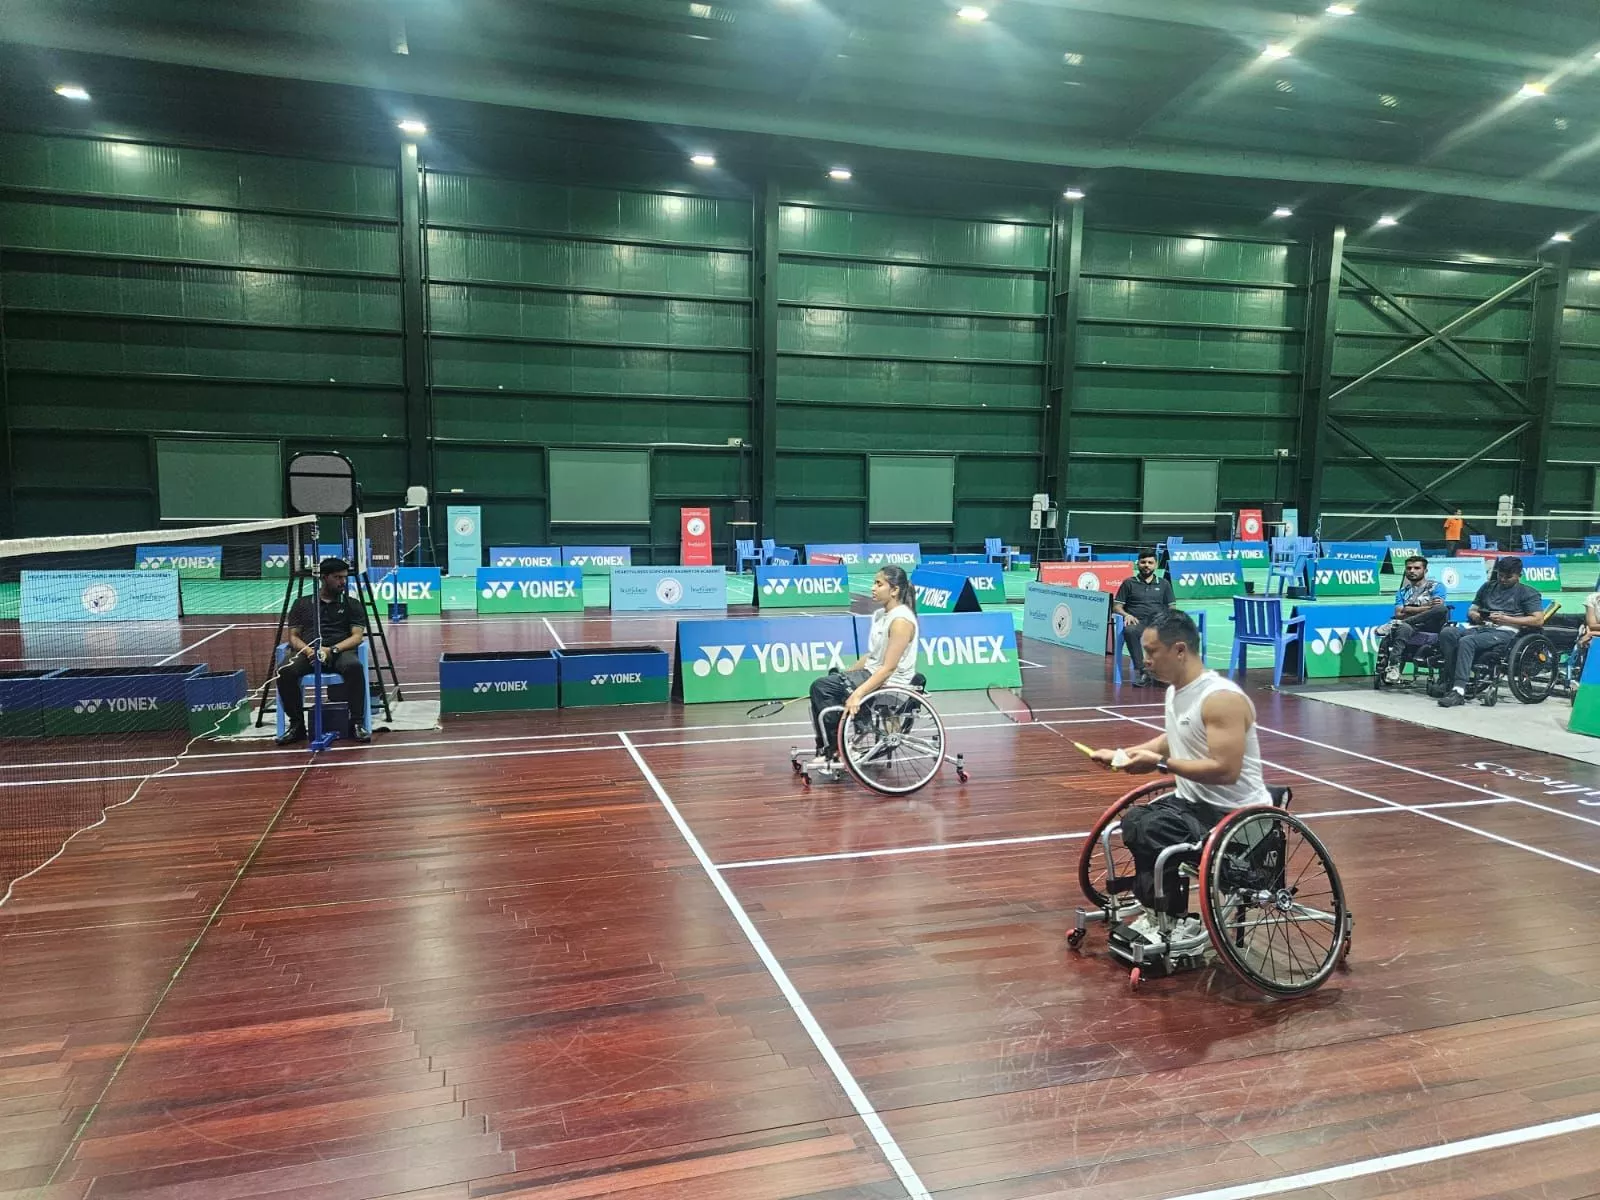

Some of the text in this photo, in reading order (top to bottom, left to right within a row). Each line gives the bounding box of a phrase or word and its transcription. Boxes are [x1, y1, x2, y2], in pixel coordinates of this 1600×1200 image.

[169, 556, 216, 570] YONEX
[518, 557, 553, 567] YONEX
[590, 556, 624, 566] YONEX
[886, 553, 915, 564] YONEX
[1200, 572, 1238, 586] YONEX
[1335, 569, 1375, 585] YONEX
[1524, 567, 1558, 582] YONEX
[372, 582, 432, 600] YONEX
[518, 580, 577, 599] YONEX
[793, 577, 844, 594] YONEX
[969, 577, 996, 591] NEX
[923, 586, 952, 609] YONEX
[752, 641, 849, 674] YONEX
[919, 635, 1009, 666] YONEX
[610, 672, 642, 684] YONEX
[494, 680, 528, 692] YONEX
[106, 697, 159, 713] YONEX
[206, 702, 233, 713] YONEX
